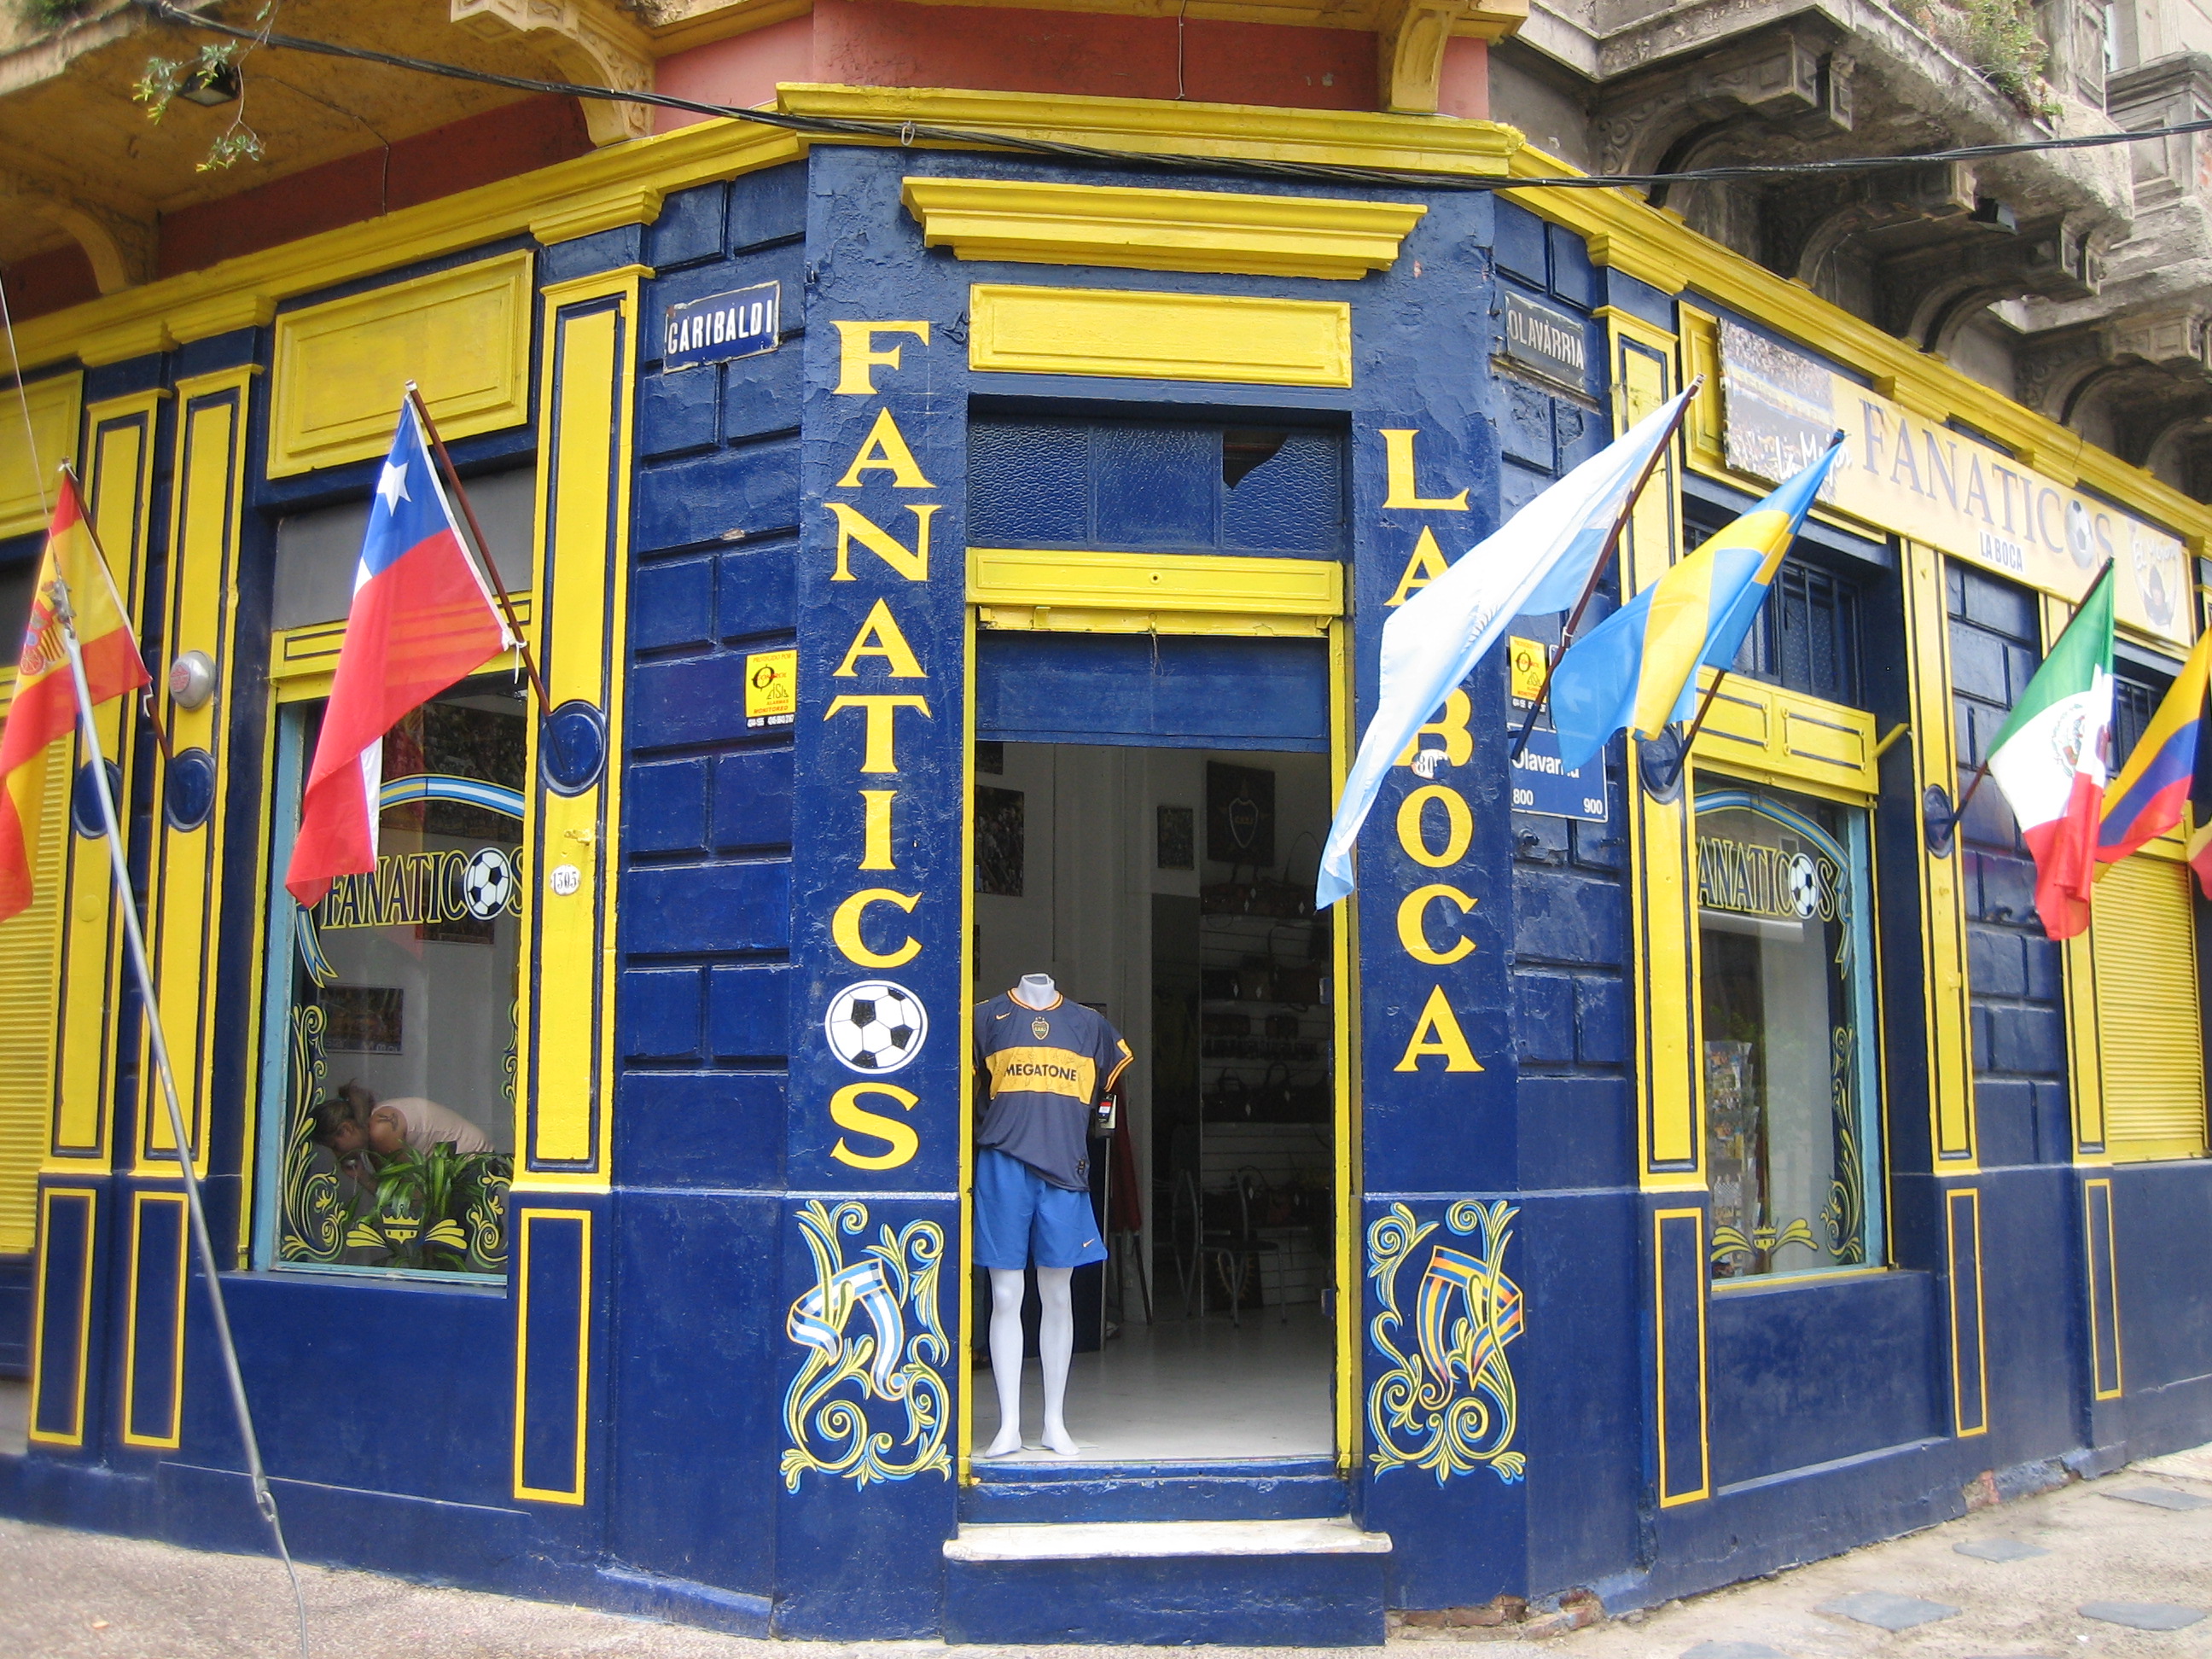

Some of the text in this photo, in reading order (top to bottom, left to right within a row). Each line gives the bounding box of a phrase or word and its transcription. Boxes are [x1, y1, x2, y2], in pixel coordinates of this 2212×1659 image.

[667, 299, 773, 355] GARIBALDI
[1378, 428, 1471, 607] LA
[1979, 531, 2023, 573] LA BOCA
[1417, 755, 1445, 773] 80
[1512, 788, 1604, 815] 800 900
[1696, 835, 1835, 922] ANATICOS
[1004, 1062, 1077, 1082] MEGATONE
